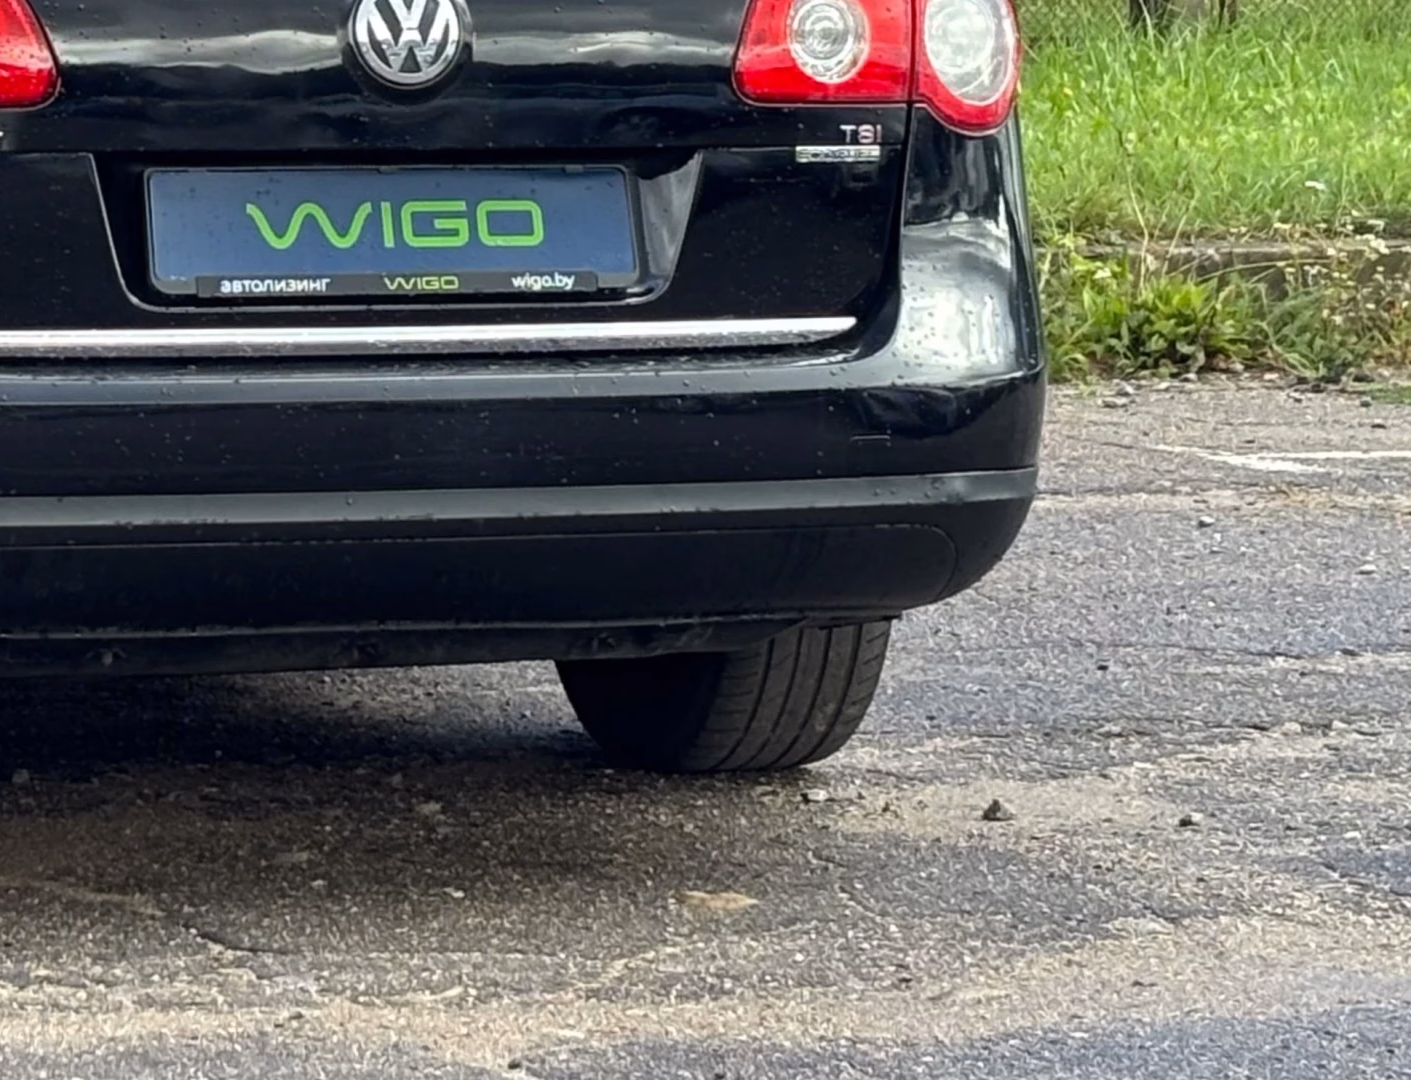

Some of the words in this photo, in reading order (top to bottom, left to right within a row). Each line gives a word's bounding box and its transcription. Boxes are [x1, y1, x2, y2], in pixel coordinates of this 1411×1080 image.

[838, 123, 883, 145] TSI
[245, 199, 545, 250] WIGO
[219, 277, 332, 294] автолизинг
[383, 275, 459, 291] WIGO
[511, 271, 576, 291] wigo.by
